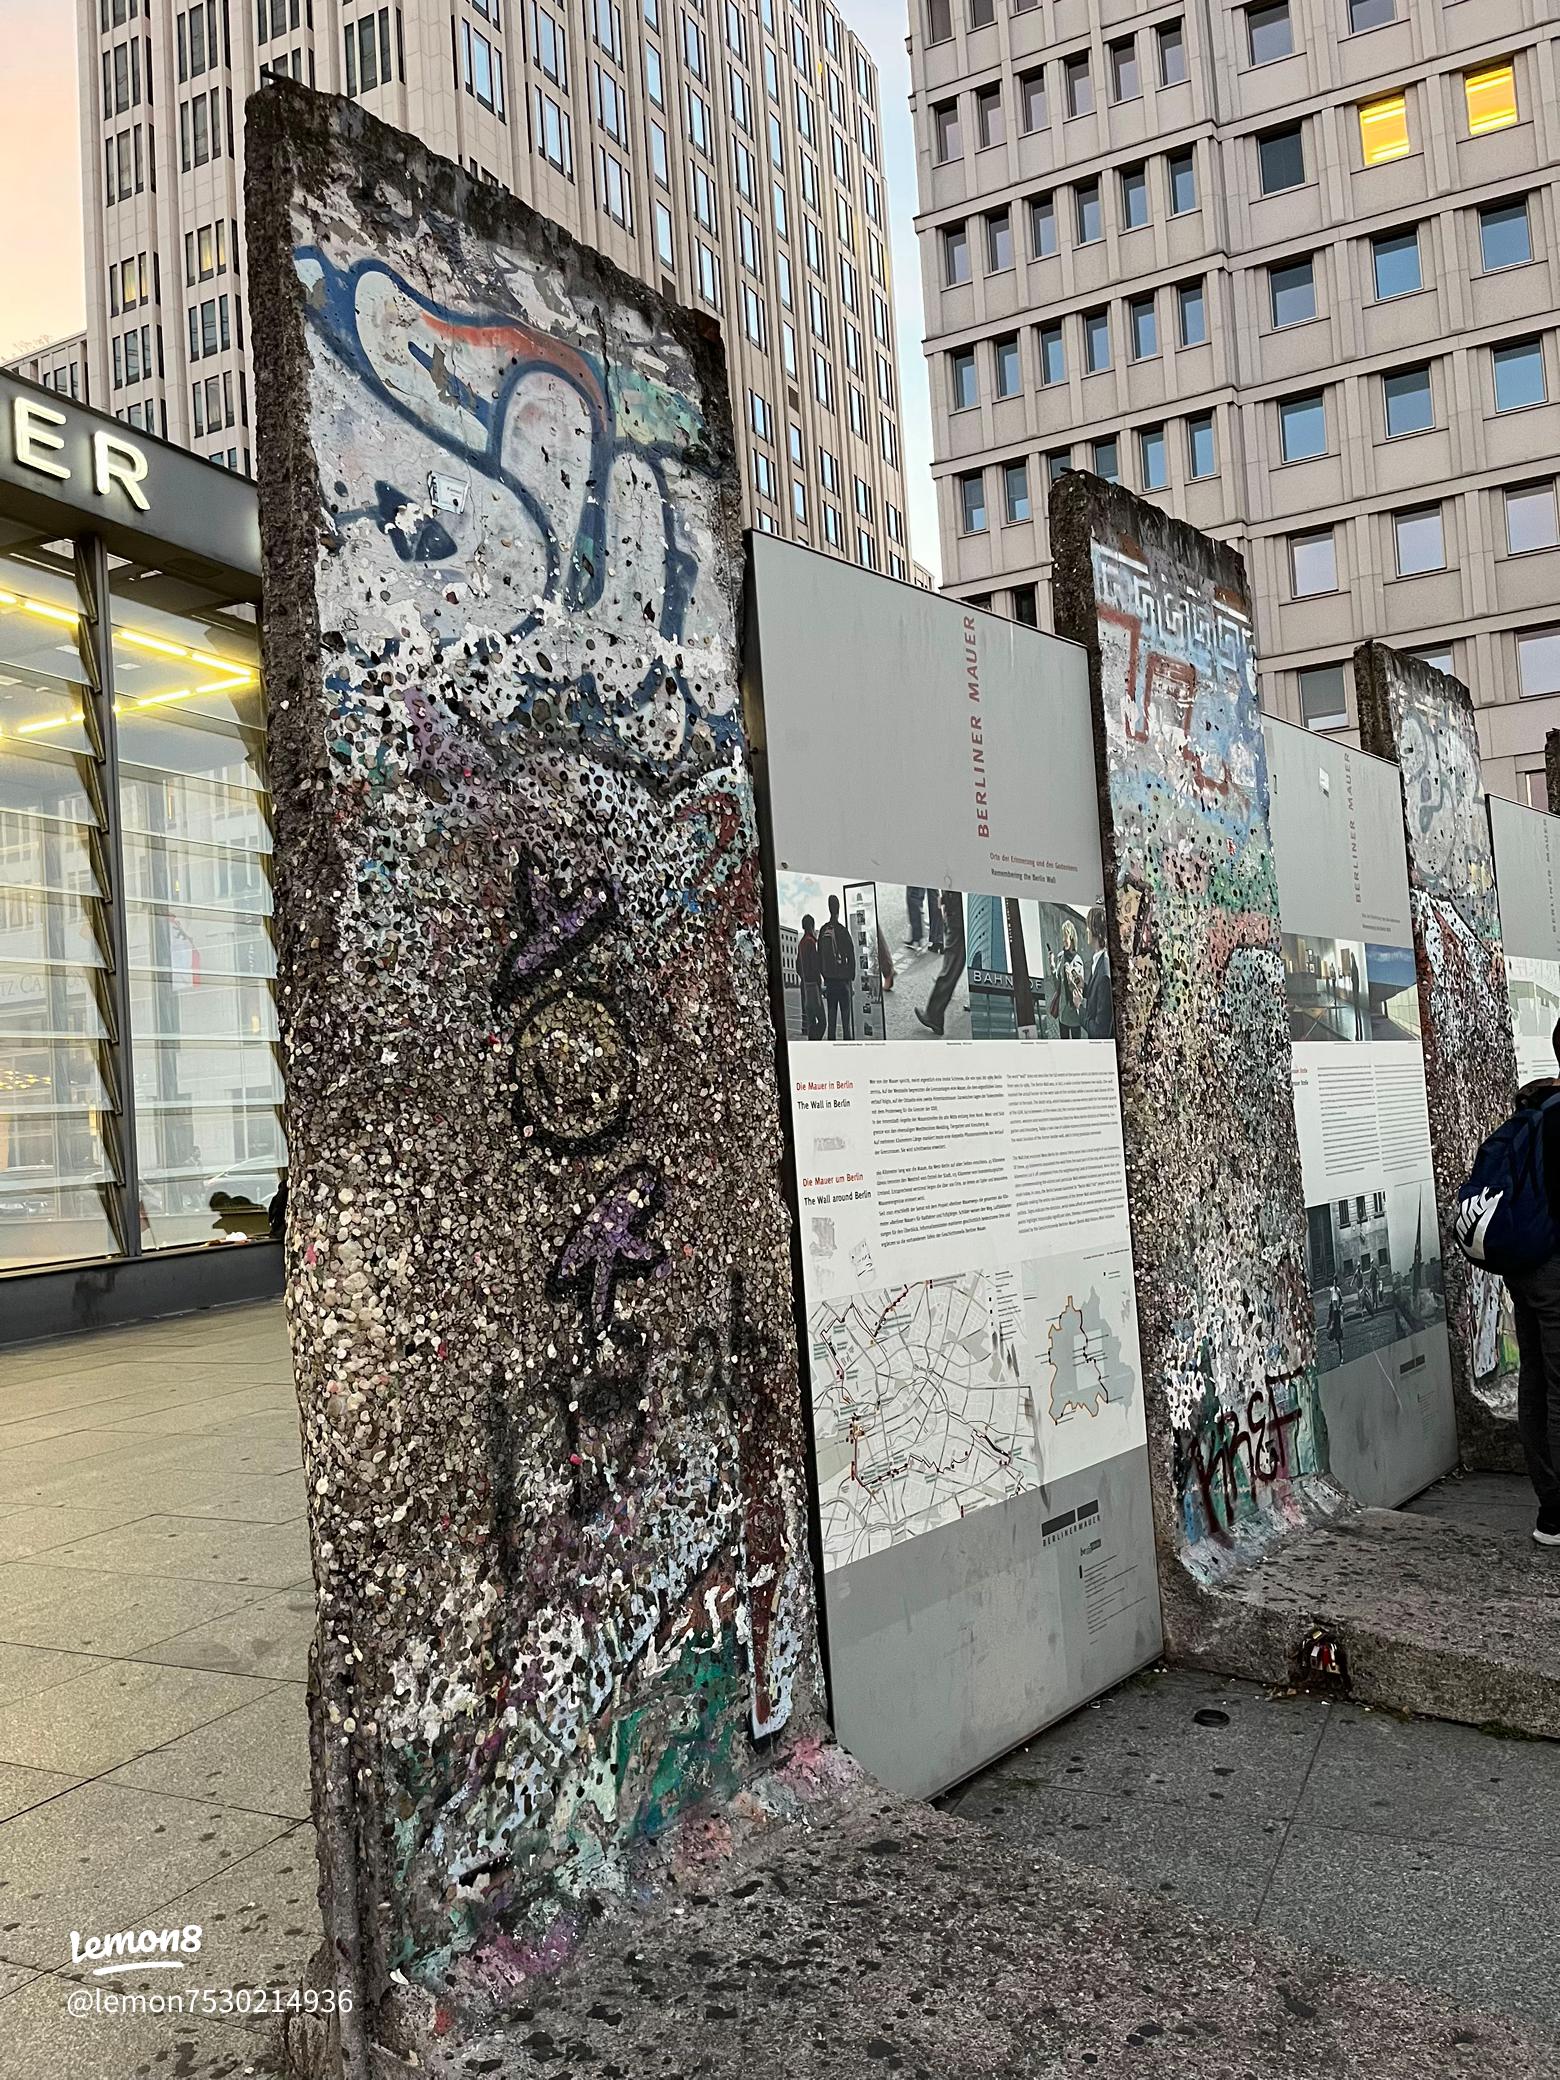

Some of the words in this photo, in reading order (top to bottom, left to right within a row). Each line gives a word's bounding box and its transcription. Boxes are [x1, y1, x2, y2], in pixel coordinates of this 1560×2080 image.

[14, 396, 151, 511] ER
[963, 615, 980, 703] MAUER
[970, 714, 990, 838] BERLINER
[796, 1082, 806, 1091] Die
[808, 1081, 827, 1090] Mauer
[829, 1081, 835, 1089] in
[837, 1080, 853, 1089] Berlin
[797, 1100, 809, 1110] The
[810, 1100, 824, 1109] Wall
[826, 1099, 831, 1108] in
[834, 1098, 850, 1108] Berlin
[802, 1177, 813, 1187] Die
[814, 1176, 833, 1185] Mauer
[835, 1175, 844, 1183] um
[846, 1173, 863, 1182] Berlin
[804, 1196, 816, 1206] The
[816, 1194, 831, 1204] Wall
[832, 1191, 853, 1203] around
[854, 1189, 871, 1200] Berlin
